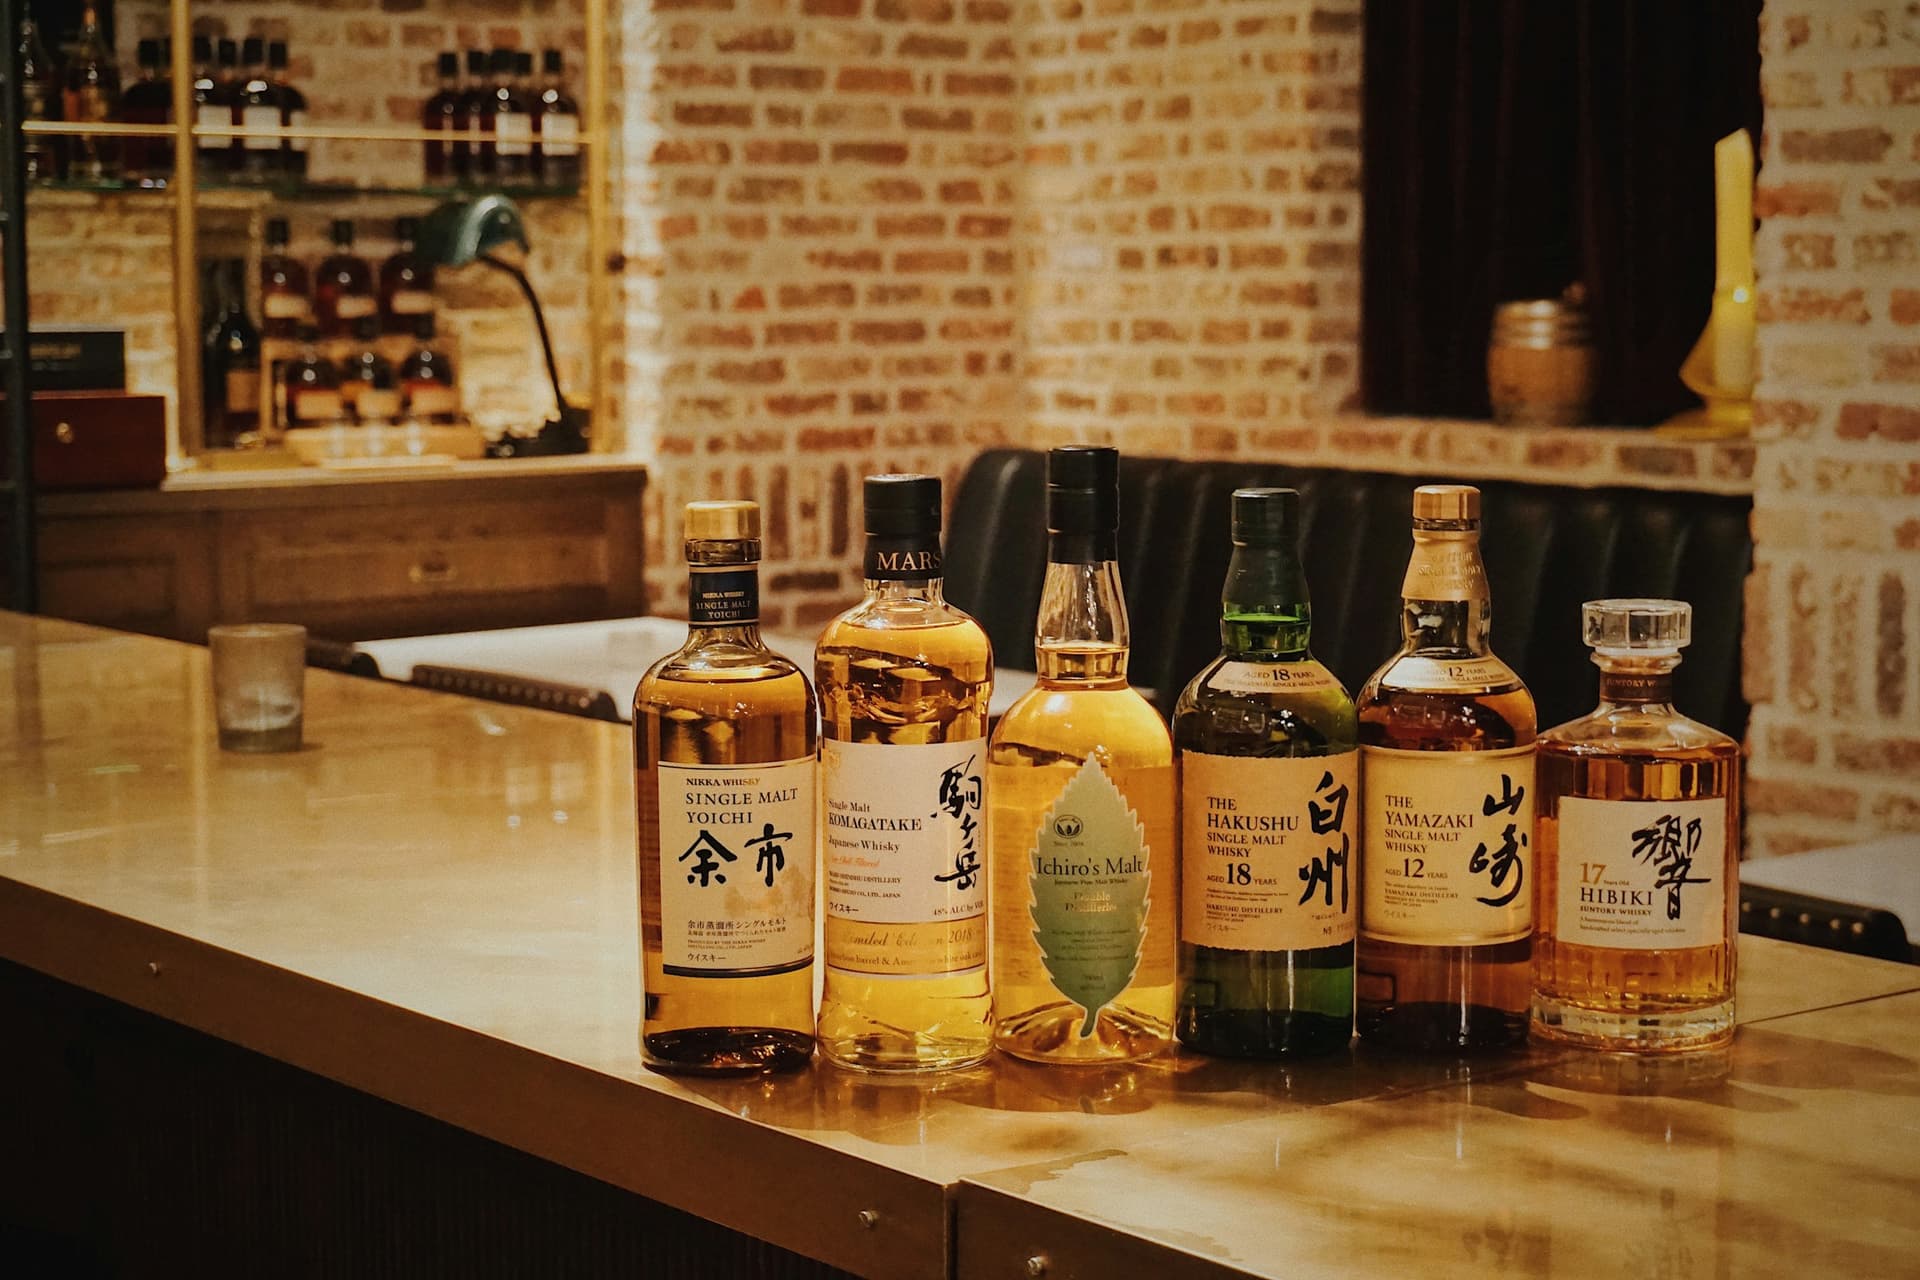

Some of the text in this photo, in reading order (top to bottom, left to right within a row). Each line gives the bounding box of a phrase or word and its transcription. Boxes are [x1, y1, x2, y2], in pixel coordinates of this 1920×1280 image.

[877, 551, 941, 571] MARS
[696, 600, 751, 610] SINGLE MALT
[708, 610, 740, 619] YOICHI
[1272, 669, 1290, 681] 18
[1291, 671, 1315, 679] YEARS
[1449, 666, 1464, 677] 12
[1606, 679, 1644, 688] SUNTORY
[686, 777, 761, 787] NIKKA WHISKY
[686, 787, 798, 806] SINGLE MALT
[1207, 797, 1238, 811] THE
[1385, 795, 1414, 809] THE
[829, 799, 870, 813] Single Malt
[686, 811, 753, 825] YOICHI
[828, 812, 922, 832] KOMAGATAKE
[930, 754, 982, 890] 駒ヶ岳
[1207, 813, 1300, 831] HAKUSHU
[1385, 811, 1474, 829] YAMAZAKI
[1207, 832, 1287, 846] SINGLE MALT
[1299, 770, 1349, 914] 白州
[1385, 829, 1461, 842] SINGLE MALT
[1469, 774, 1528, 907] 山崎
[829, 835, 900, 854] Japanese Whisky
[1207, 845, 1252, 858] WHISKY
[1385, 841, 1428, 854] WHISKY
[678, 823, 793, 887] 余市
[1037, 855, 1143, 876] Ichiro's Malt
[1385, 857, 1448, 879] AGED 12 YEARS
[1632, 815, 1712, 920] 響
[1207, 862, 1278, 886] AGED 18 YEARS
[1580, 862, 1606, 885] 17
[1580, 886, 1653, 906] HIBIKI
[950, 904, 965, 914] ALC
[1580, 905, 1653, 917] SUNTORY WHISKY
[948, 928, 973, 945] 2018
[687, 952, 727, 963] ウイスキー
